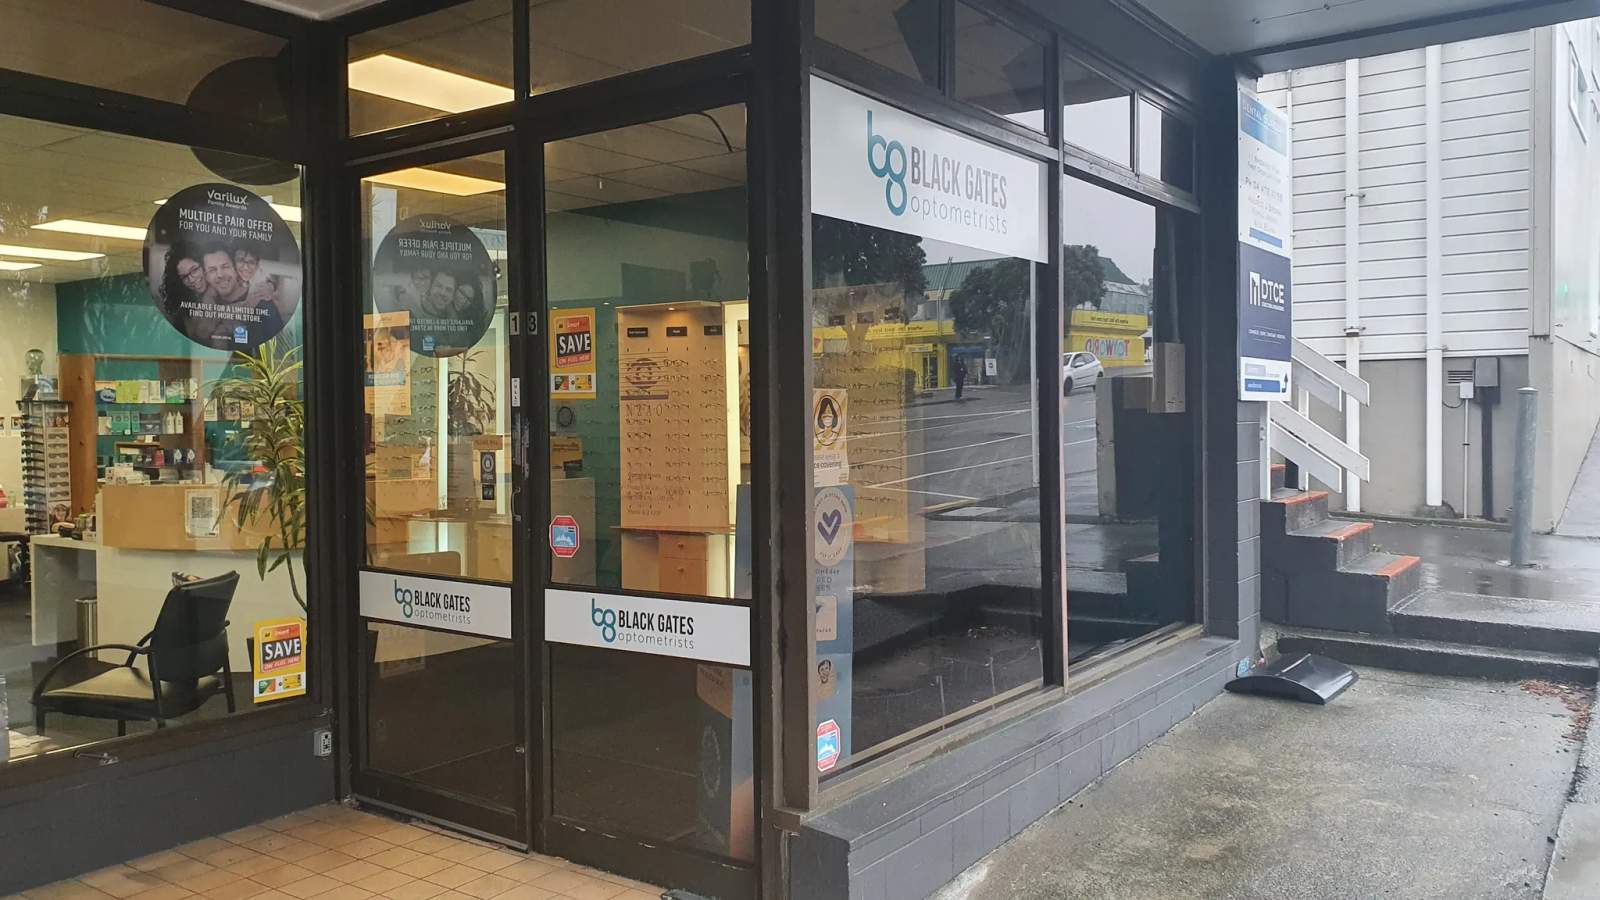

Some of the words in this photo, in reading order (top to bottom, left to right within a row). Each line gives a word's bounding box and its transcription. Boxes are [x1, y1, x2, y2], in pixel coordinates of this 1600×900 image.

[911, 146, 961, 197] BLACK
[965, 163, 1008, 211] GATES
[207, 189, 248, 205] Varilux
[179, 208, 223, 225] MULTIPLE
[224, 215, 245, 228] PAIR
[247, 219, 273, 232] OFFER
[910, 195, 1008, 235] optometrists
[179, 221, 194, 231] FOR
[195, 223, 210, 233] YOU
[211, 225, 227, 236] AND
[228, 228, 247, 239] YOUR
[248, 231, 273, 242] FAMILY
[1261, 278, 1285, 304] DTCE
[180, 301, 214, 311] AVAILABLE
[213, 304, 226, 312] FOR
[231, 306, 255, 315] LIMITED
[255, 308, 271, 317] TIME.
[189, 309, 204, 318] FIND
[204, 310, 217, 319] OUT
[217, 312, 235, 320] MORE
[559, 333, 591, 355] SAVE
[414, 590, 442, 609] BLACK
[443, 593, 471, 613] GATES
[414, 608, 472, 625] optometrists
[618, 609, 655, 632] BLACK
[657, 614, 694, 636] GATES
[265, 638, 300, 660] SAVE
[618, 631, 695, 650] optometrists
